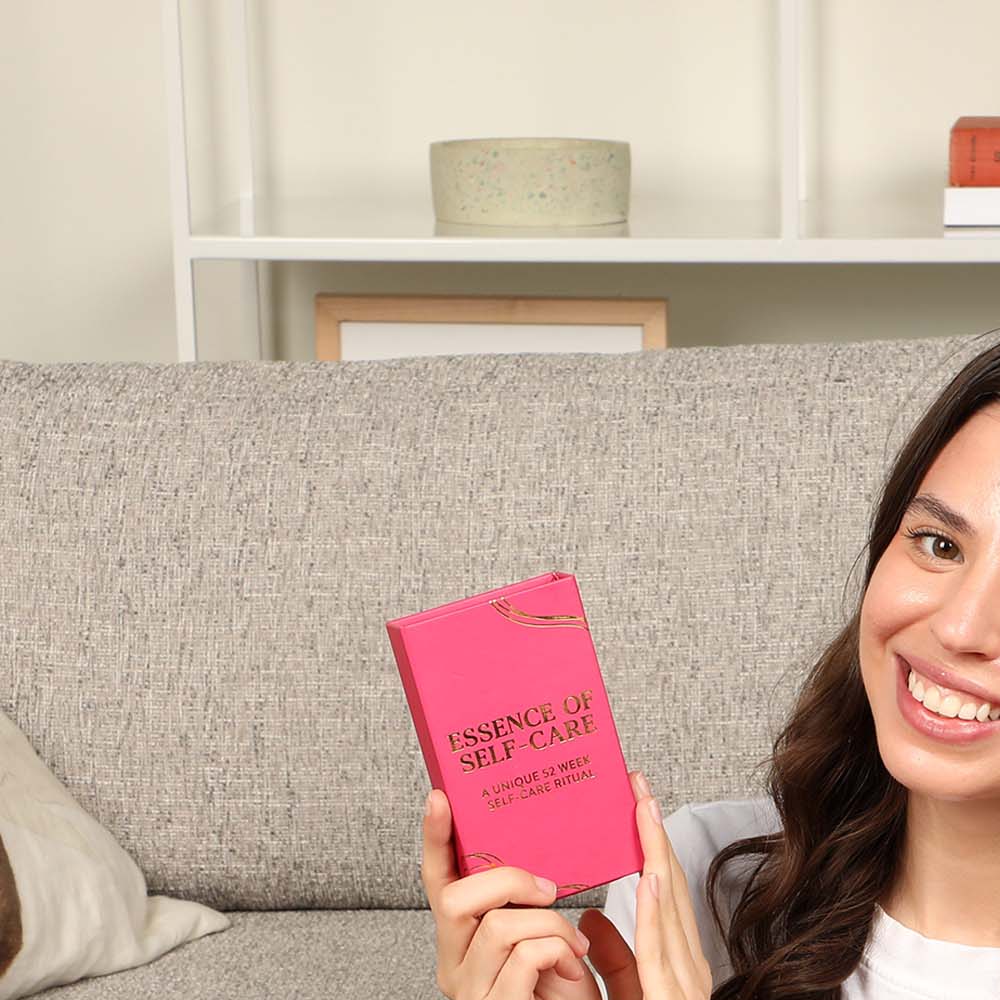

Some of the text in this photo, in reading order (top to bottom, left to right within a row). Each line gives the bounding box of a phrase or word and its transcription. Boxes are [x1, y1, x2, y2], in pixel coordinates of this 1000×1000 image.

[447, 689, 593, 753] ESSENCE OF
[459, 713, 597, 774] SELF-CARE
[481, 754, 592, 799] A UNIQUE 52 WEEK
[487, 769, 596, 811] SELF-CARE RITUAL
